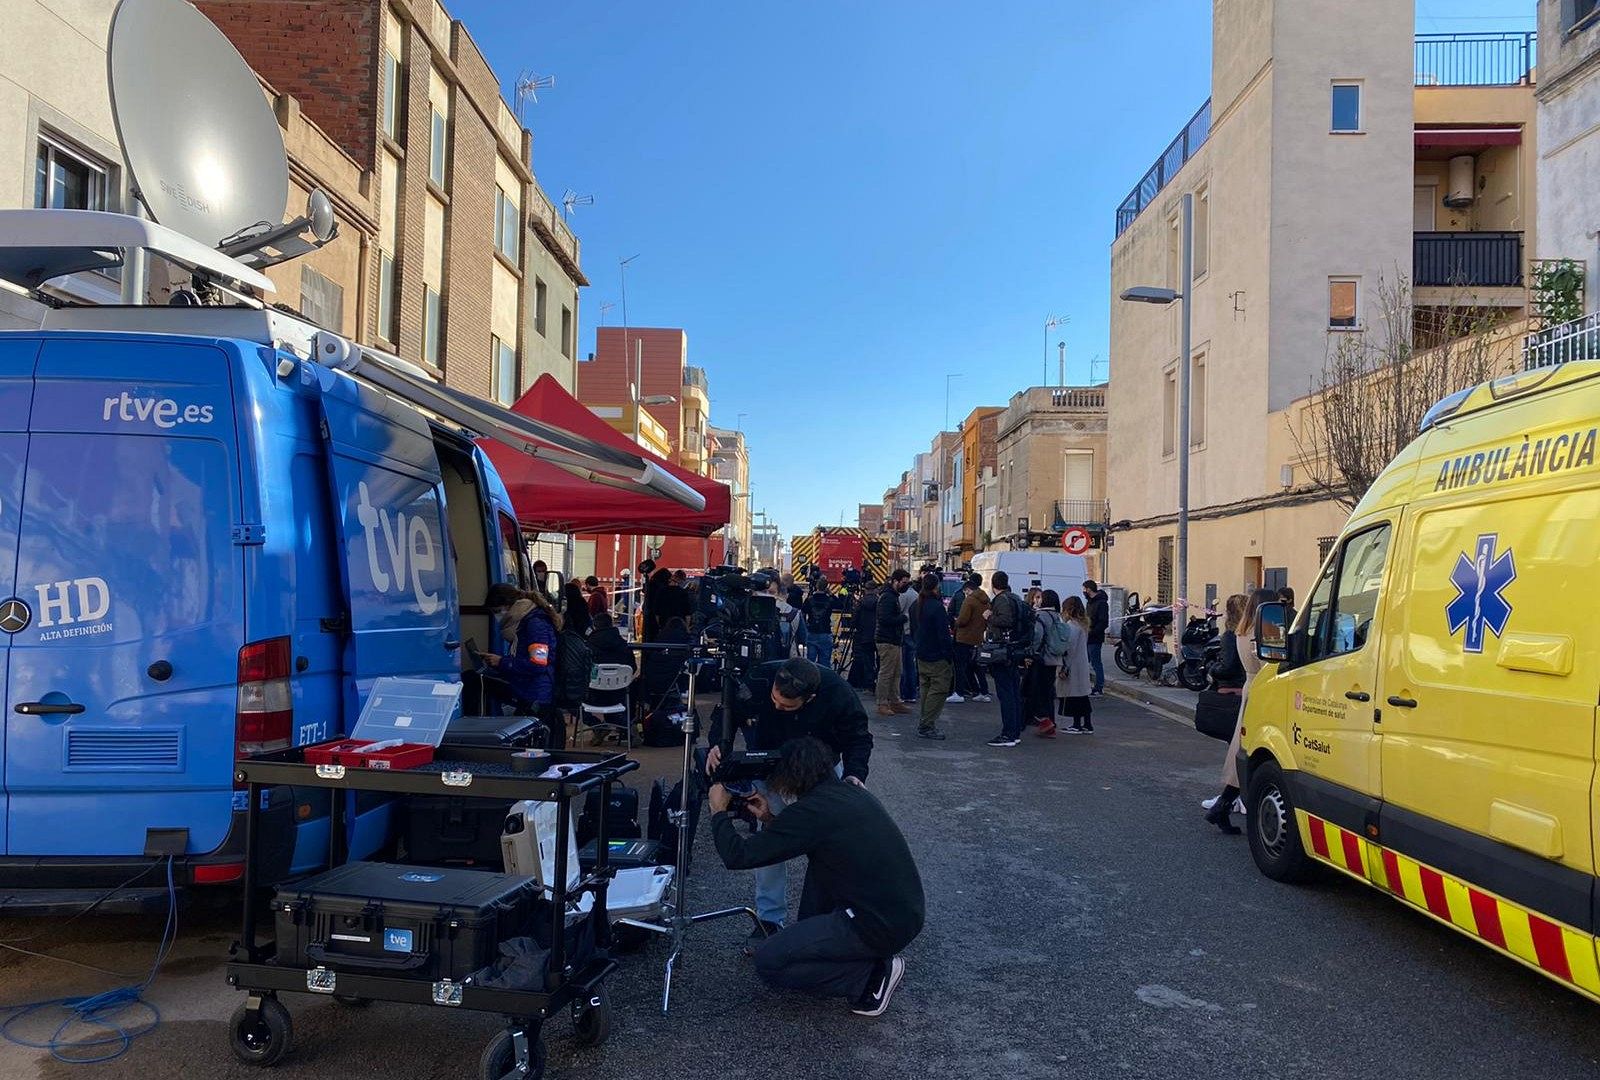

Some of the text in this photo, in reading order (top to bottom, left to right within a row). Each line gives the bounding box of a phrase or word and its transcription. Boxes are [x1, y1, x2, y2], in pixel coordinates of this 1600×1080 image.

[103, 391, 213, 428] rtve.es
[1434, 428, 1598, 492] AMBULÀNCIA
[357, 481, 438, 615] tve
[35, 577, 110, 627] HD
[40, 623, 113, 641] ALTA DEFINICIÓN
[1303, 736, 1331, 754] CatSalut
[390, 933, 407, 947] tve
